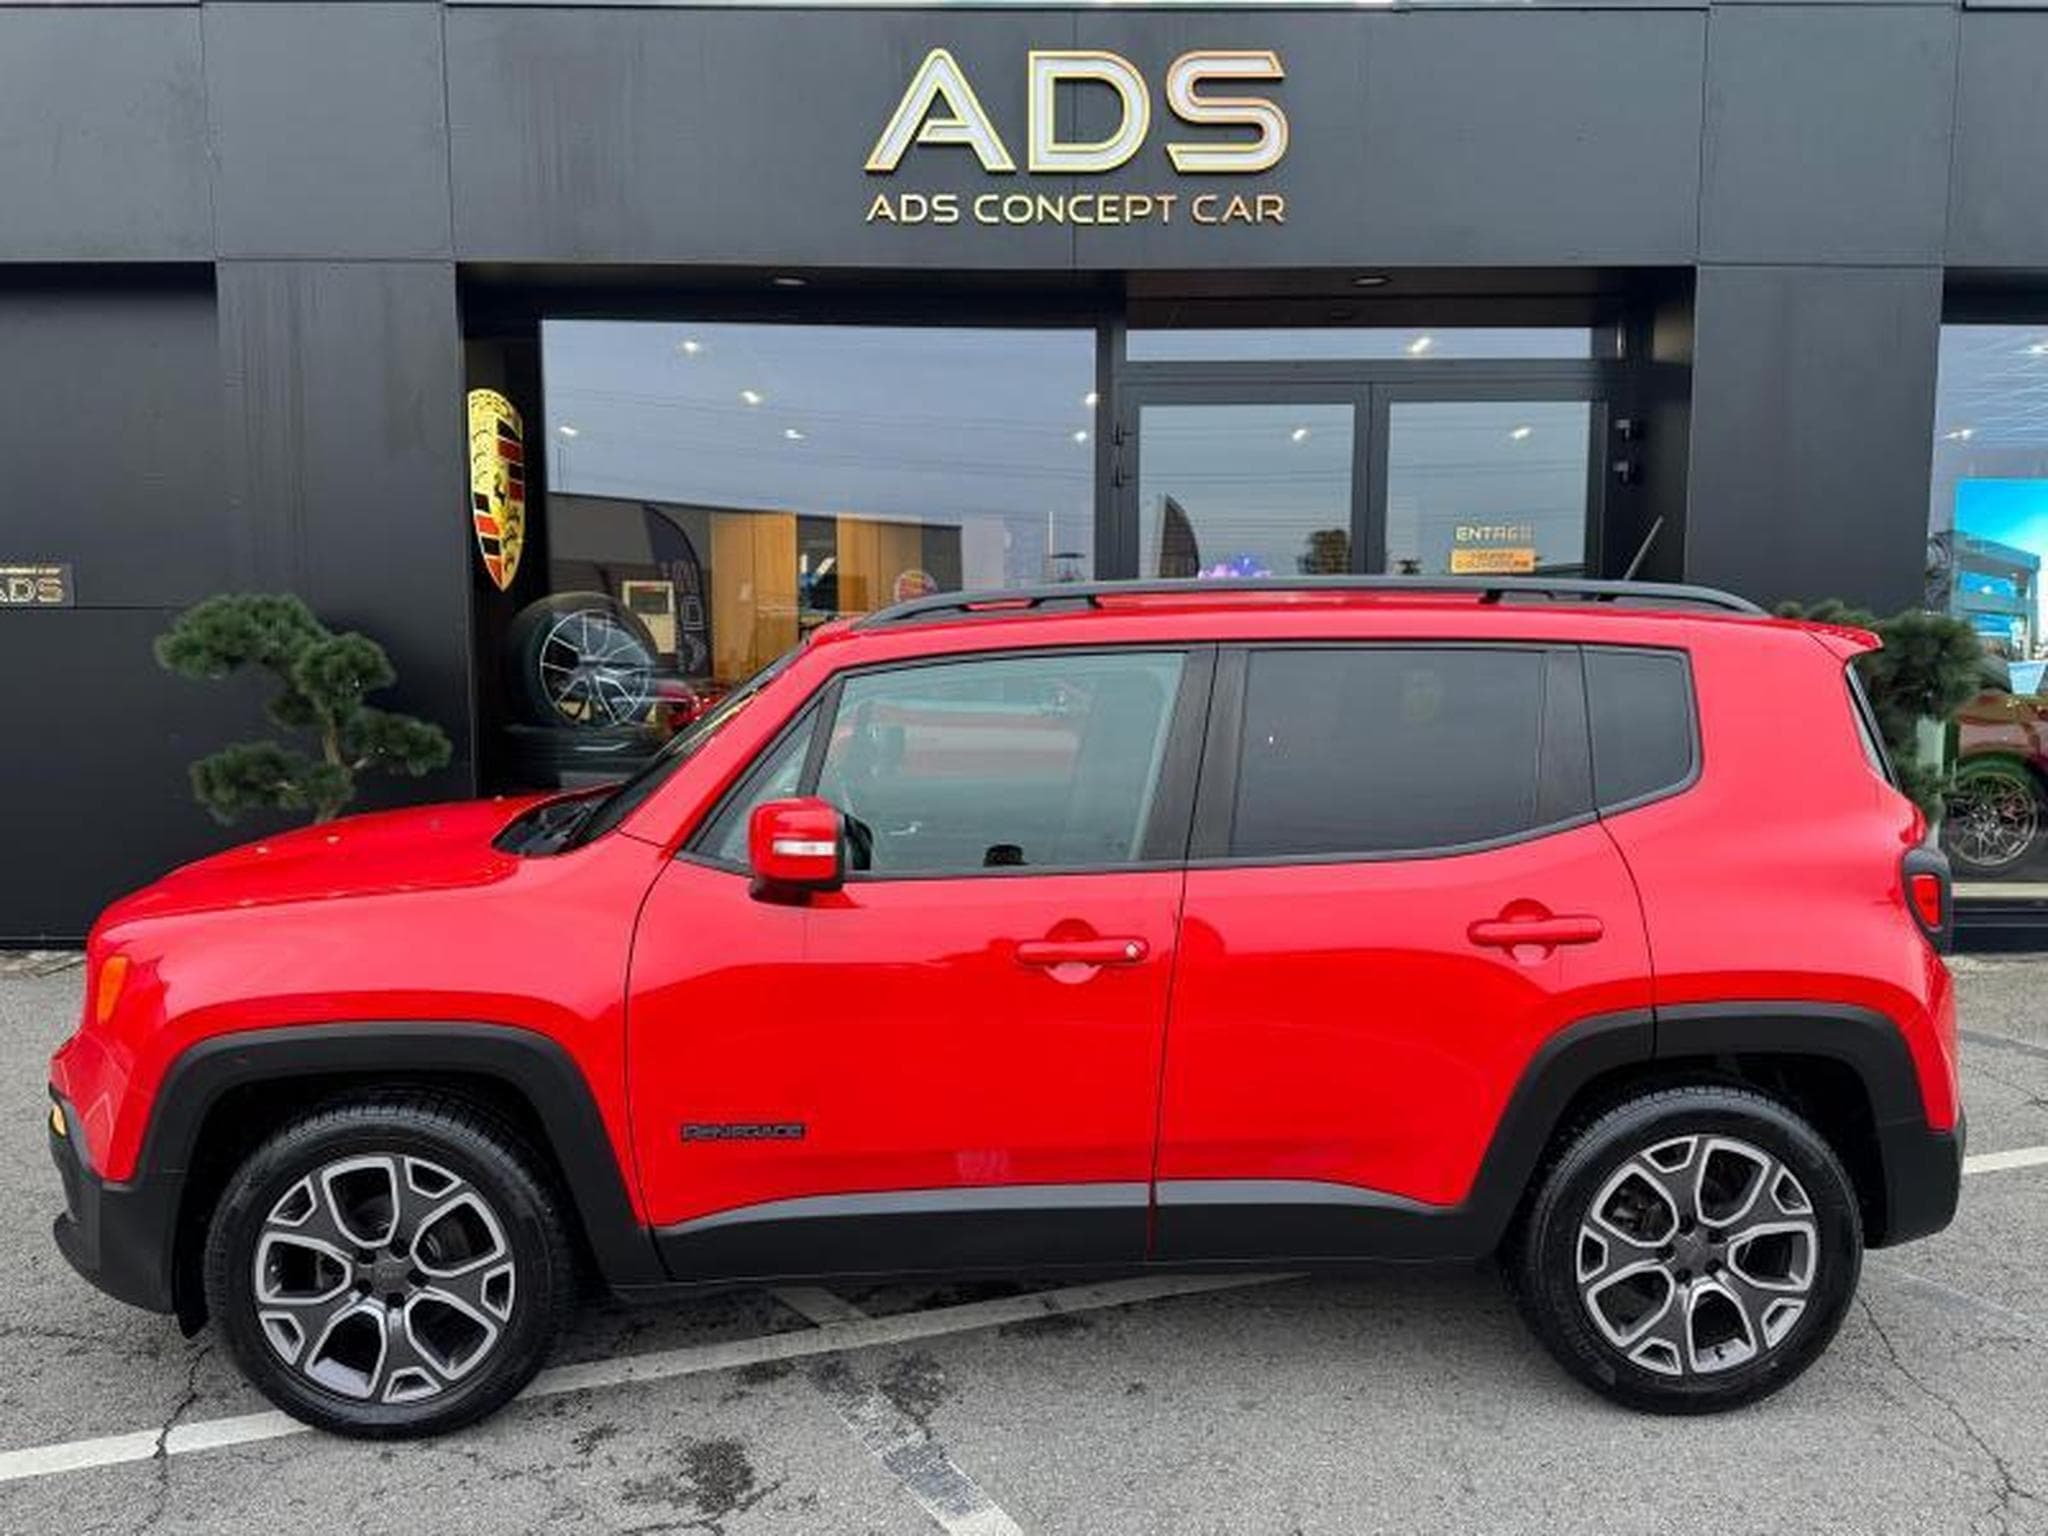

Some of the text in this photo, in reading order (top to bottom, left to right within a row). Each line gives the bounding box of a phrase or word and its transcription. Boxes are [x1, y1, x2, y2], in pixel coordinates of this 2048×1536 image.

[864, 48, 1289, 173] ADS
[865, 193, 1286, 224] ADS CONCEPT CAR
